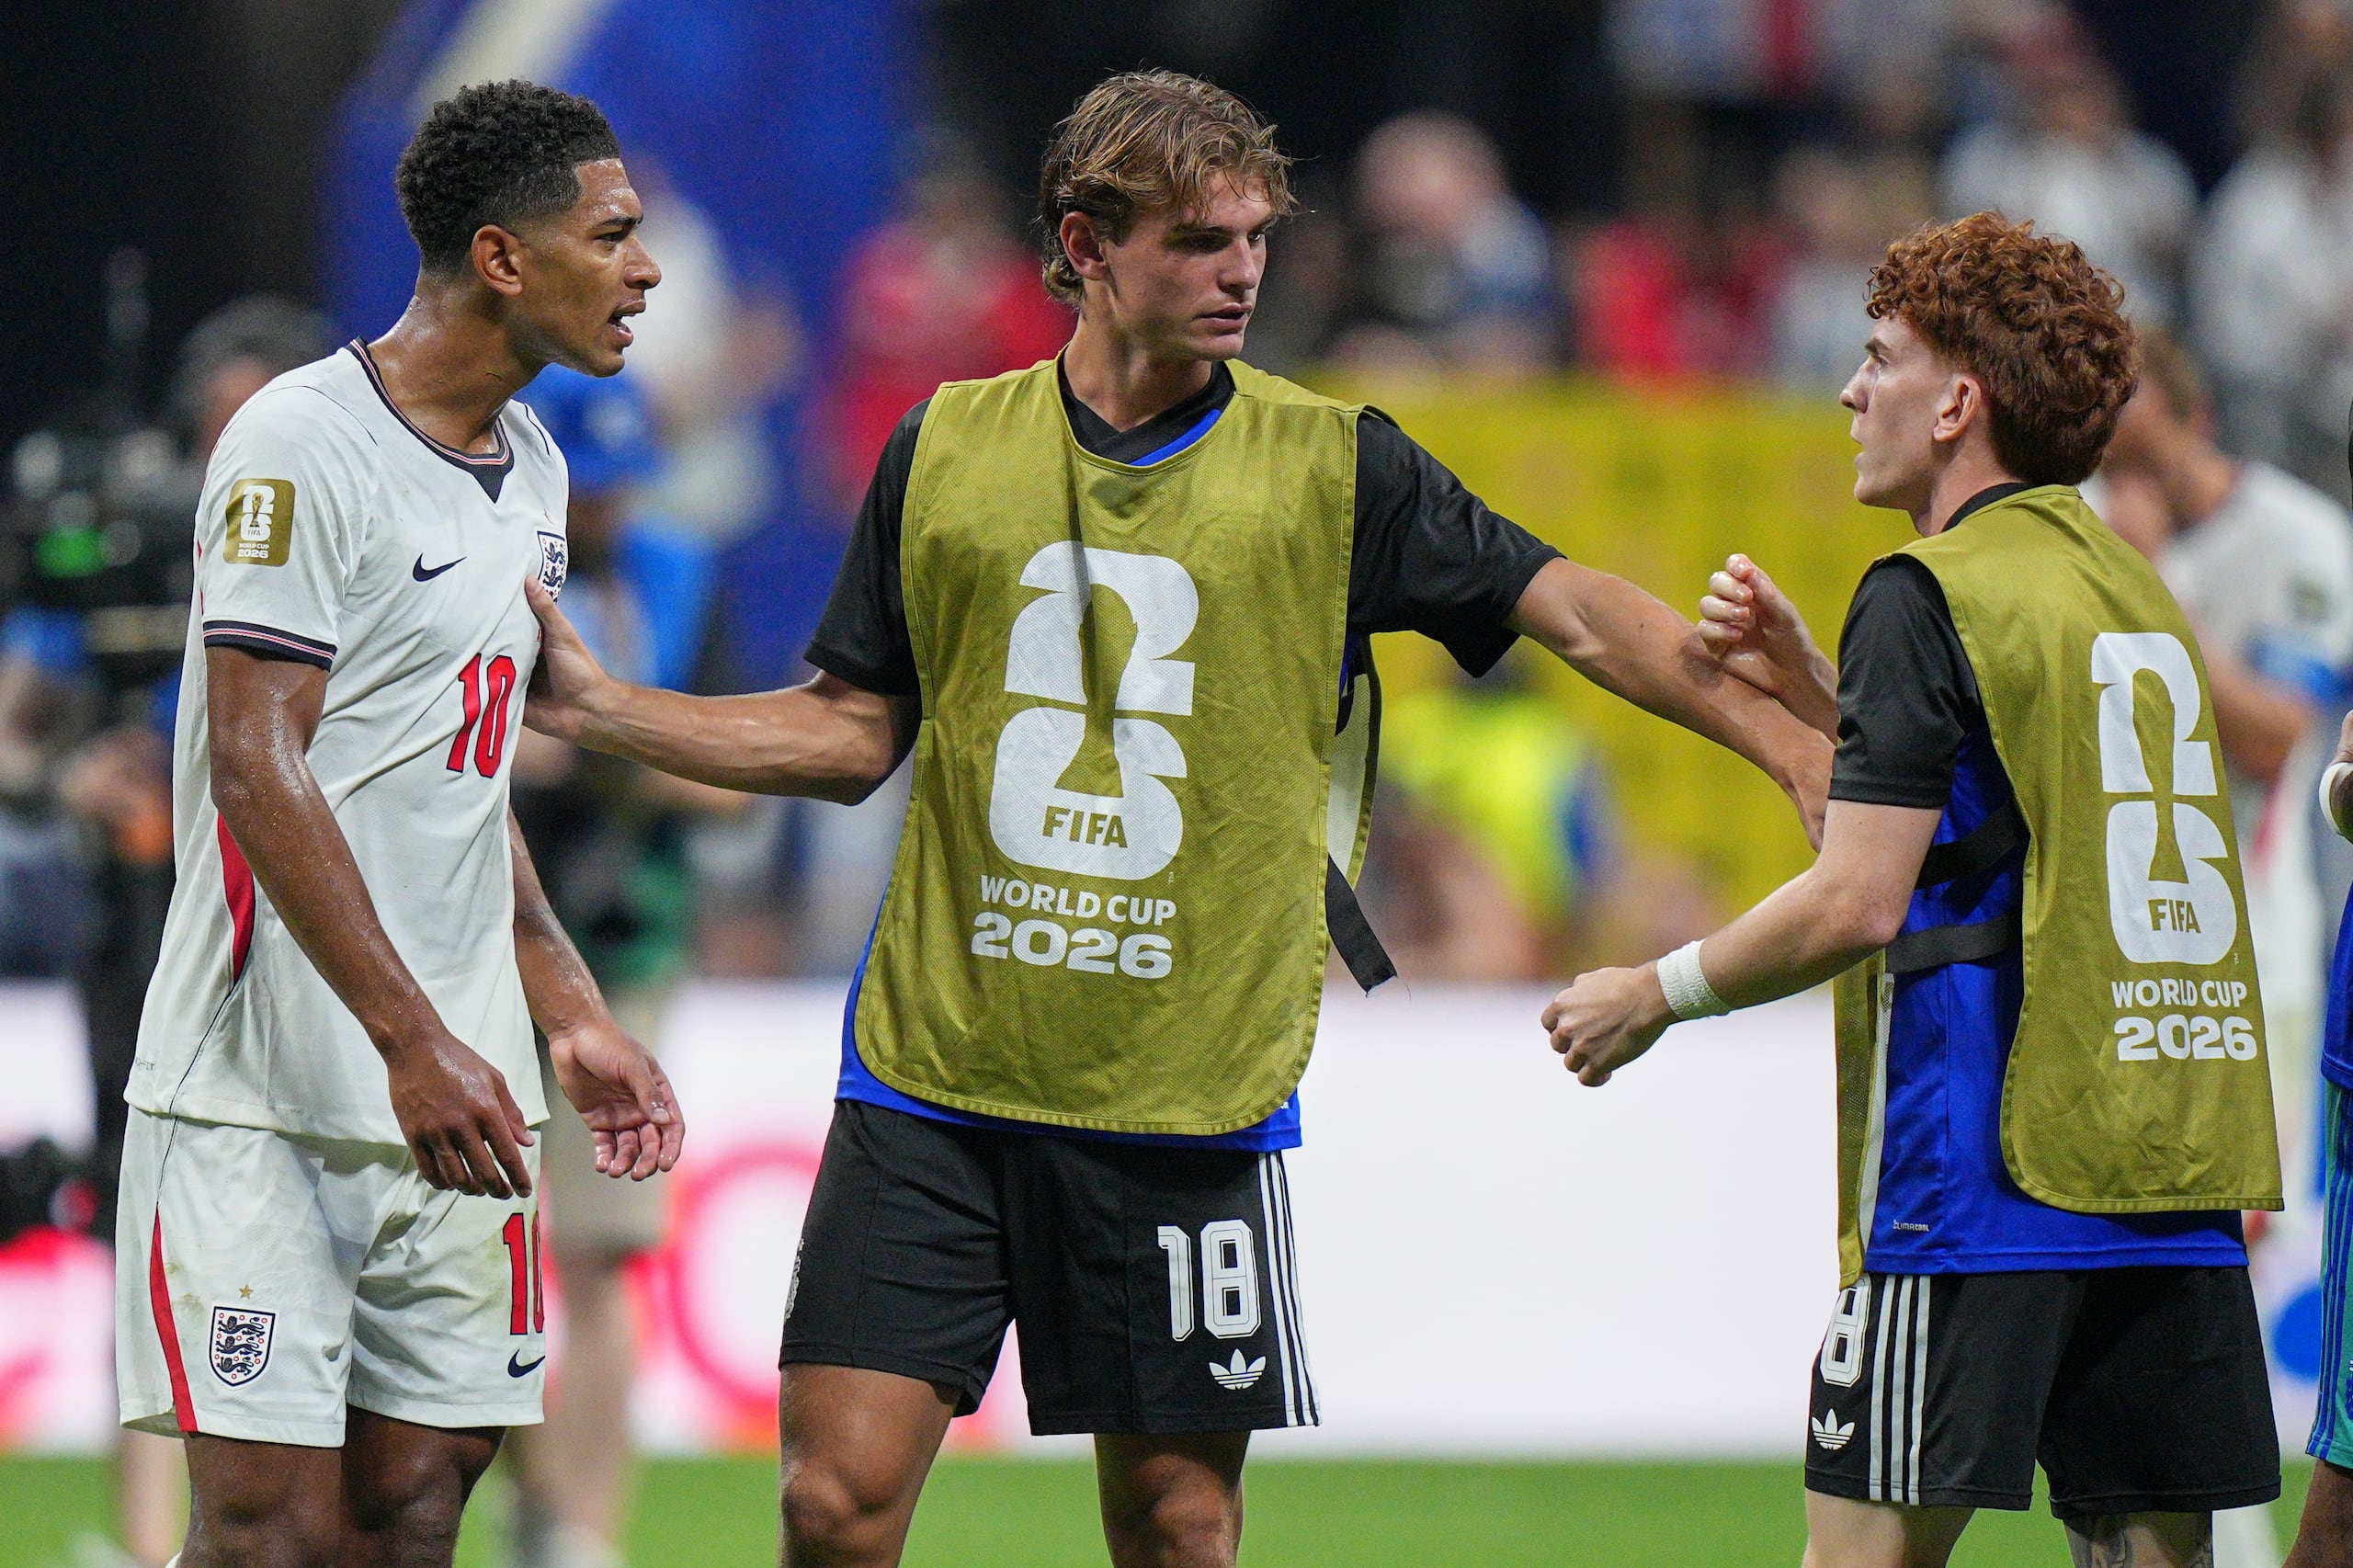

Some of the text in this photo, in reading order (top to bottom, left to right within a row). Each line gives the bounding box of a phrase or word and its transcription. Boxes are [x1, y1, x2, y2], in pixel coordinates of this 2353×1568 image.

[237, 549, 269, 559] 2026
[446, 653, 517, 778] 10
[1042, 805, 1128, 848] FIFA
[980, 874, 1176, 926] WORLD CUP
[2147, 899, 2201, 934] FIFA
[971, 911, 1173, 980] 2026
[2110, 978, 2247, 1008] WORLD CUP
[2114, 1014, 2257, 1062] 2026
[503, 1211, 545, 1335] 10
[1157, 1219, 1262, 1342] 18
[1820, 1272, 1872, 1388] 8
